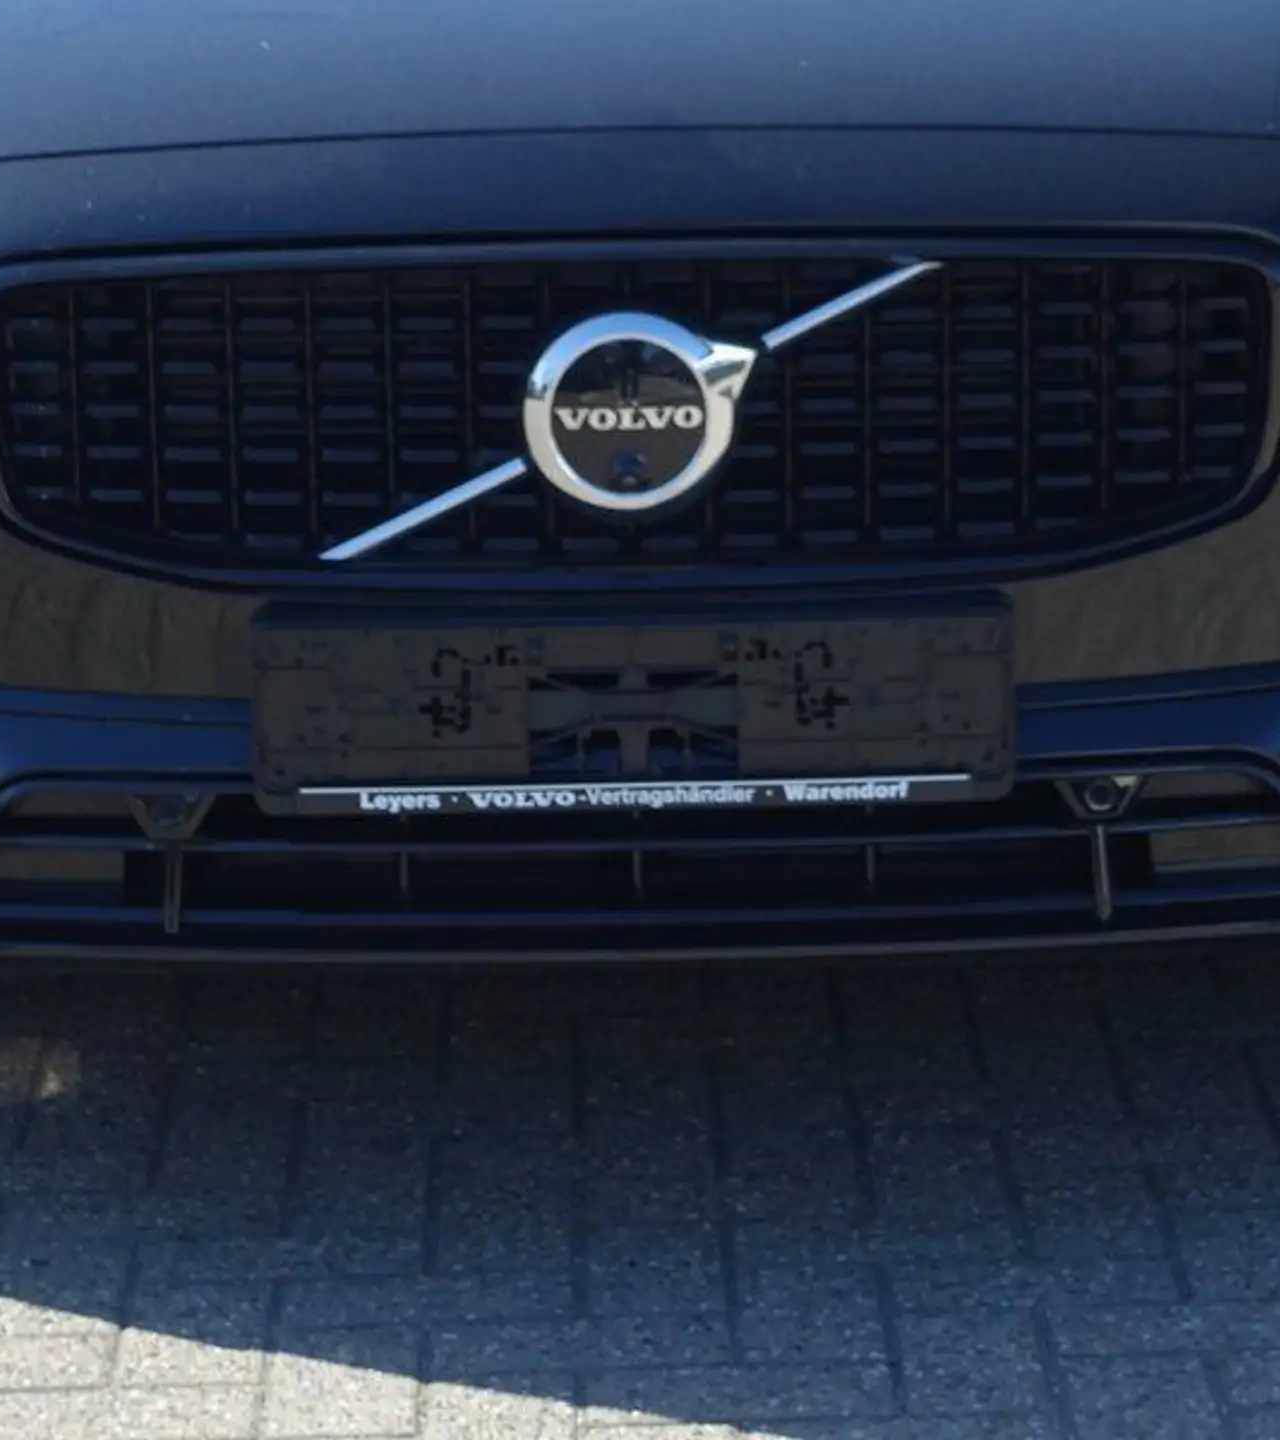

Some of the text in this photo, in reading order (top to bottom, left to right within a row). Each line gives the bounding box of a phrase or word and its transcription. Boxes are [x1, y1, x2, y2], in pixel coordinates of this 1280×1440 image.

[555, 406, 703, 430] VOLVO
[359, 791, 441, 814] Leyers
[783, 781, 909, 801] Warendorf
